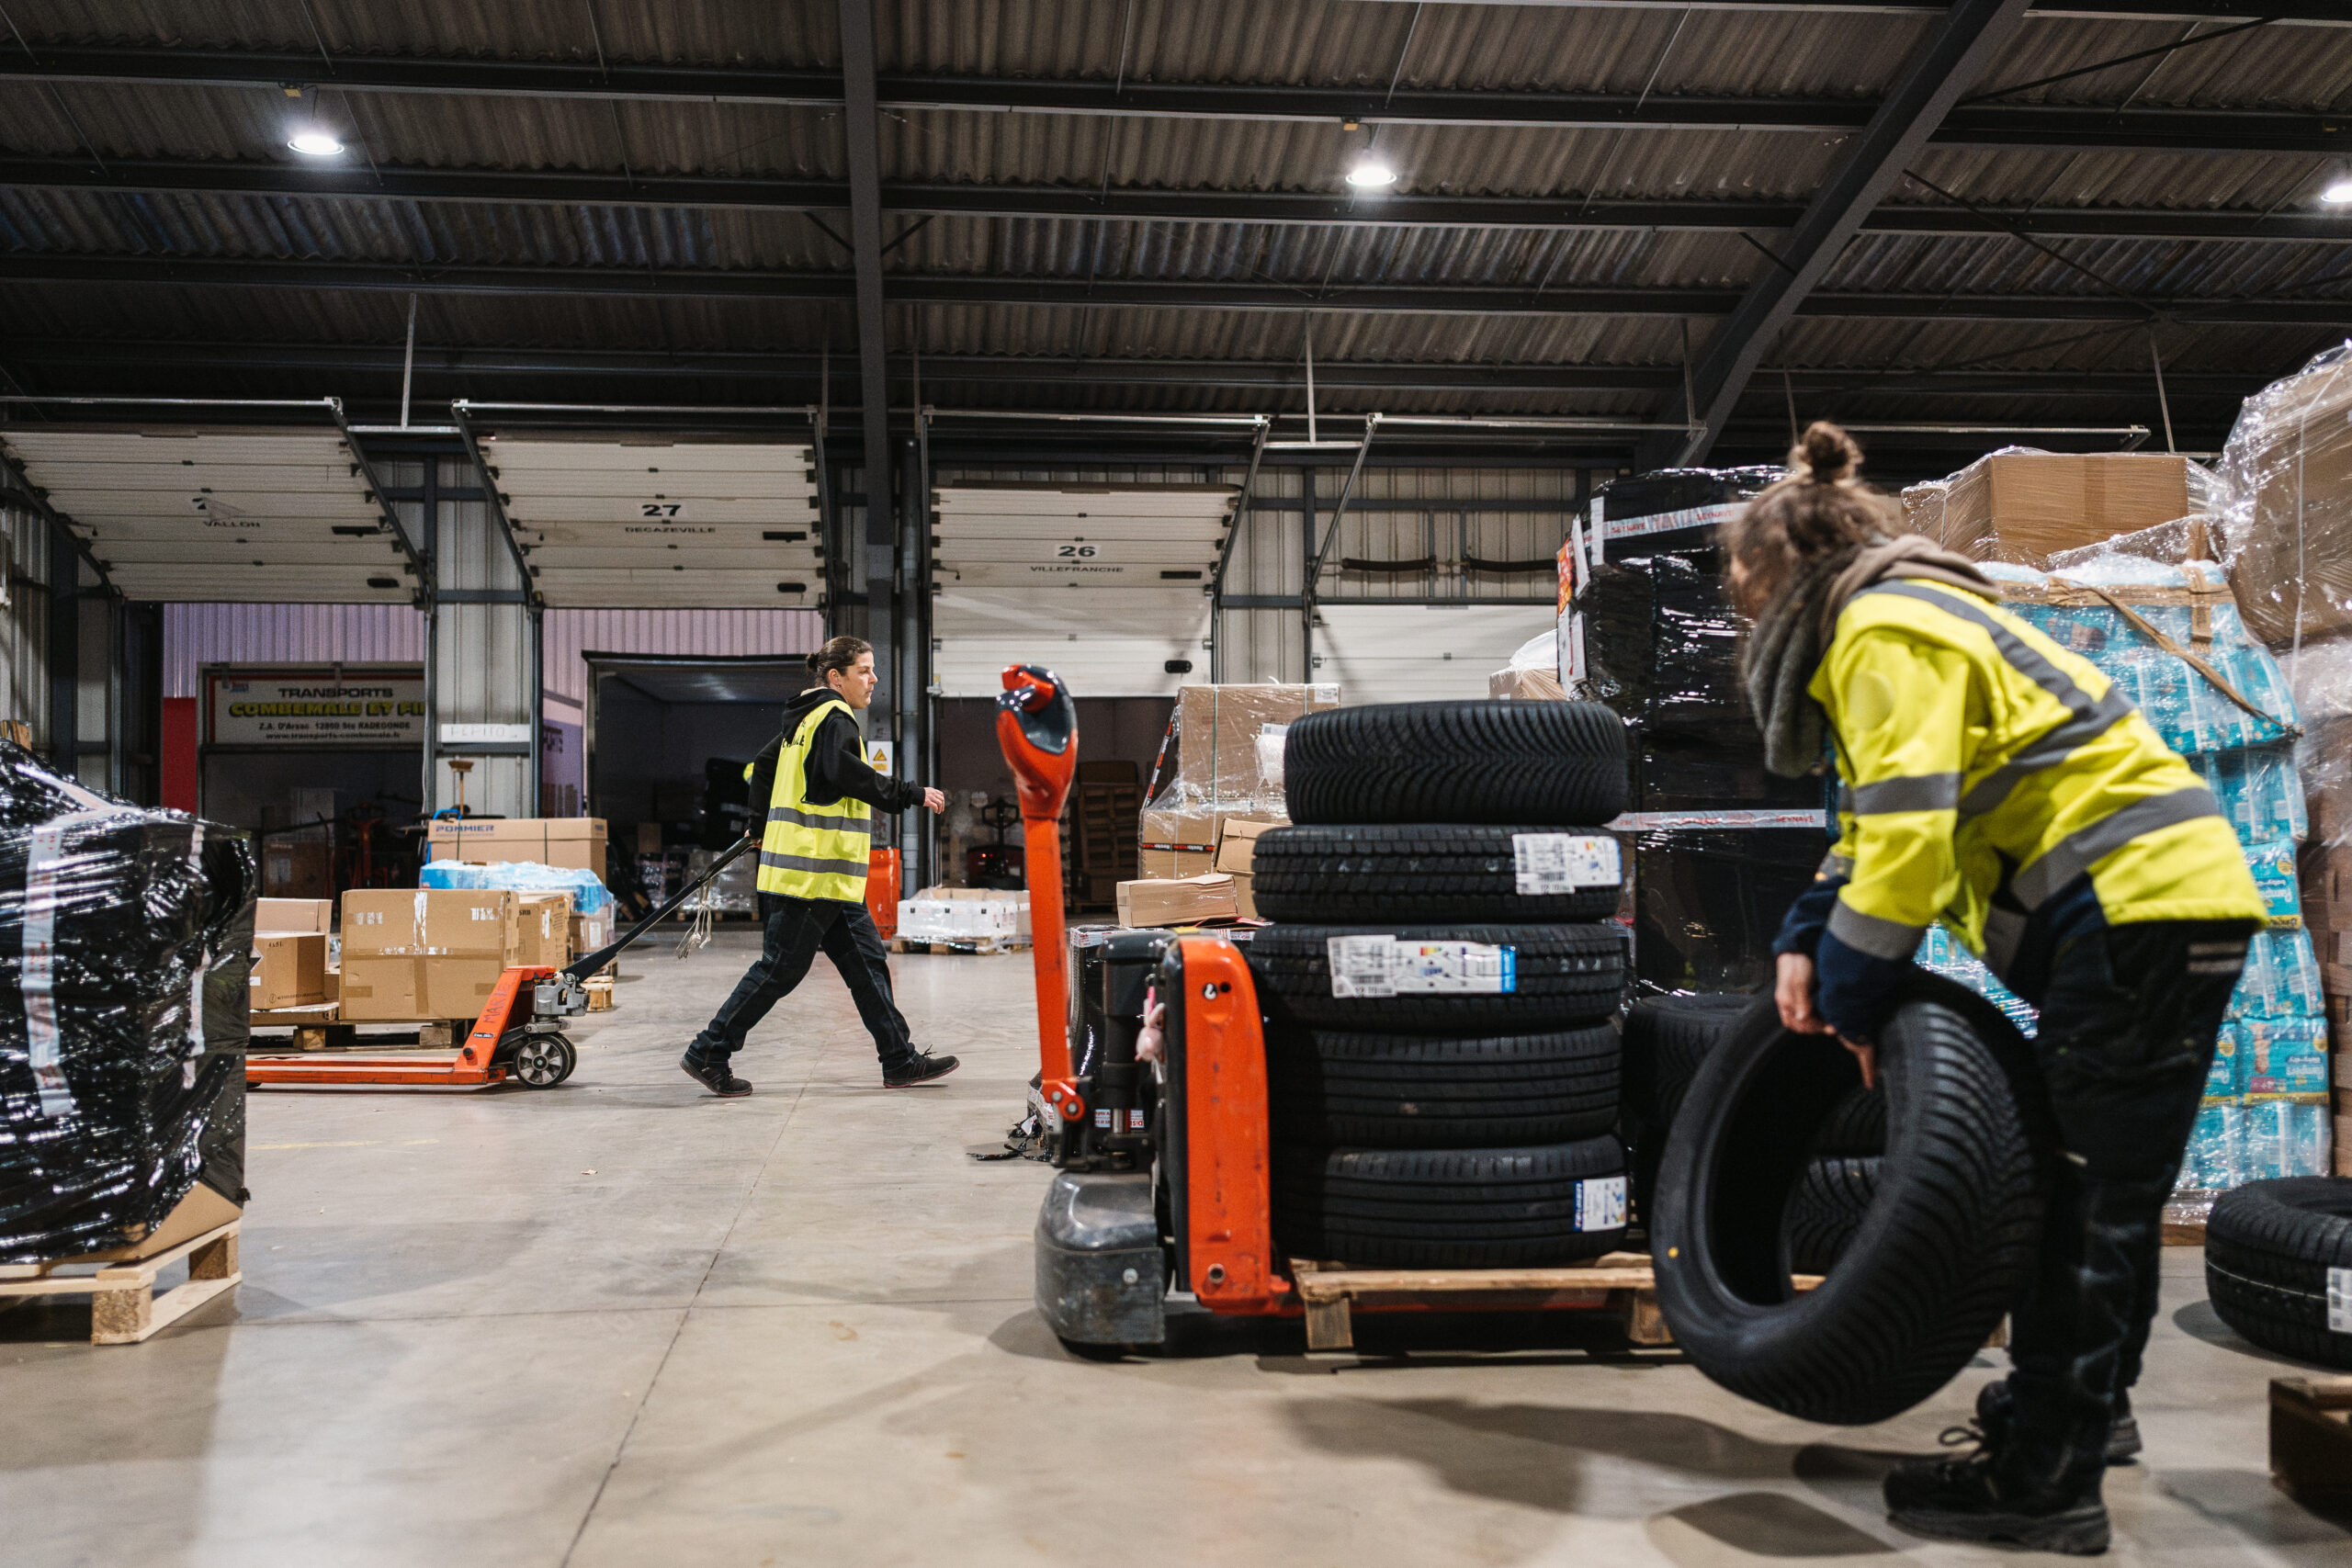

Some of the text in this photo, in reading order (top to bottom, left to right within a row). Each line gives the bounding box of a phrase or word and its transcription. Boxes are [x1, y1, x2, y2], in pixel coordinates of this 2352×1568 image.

[641, 504, 681, 516] 27
[1057, 546, 1096, 558] 26
[277, 687, 393, 698] TRANSPORTS
[229, 702, 362, 717] COMBEMALE
[367, 702, 395, 716] ET
